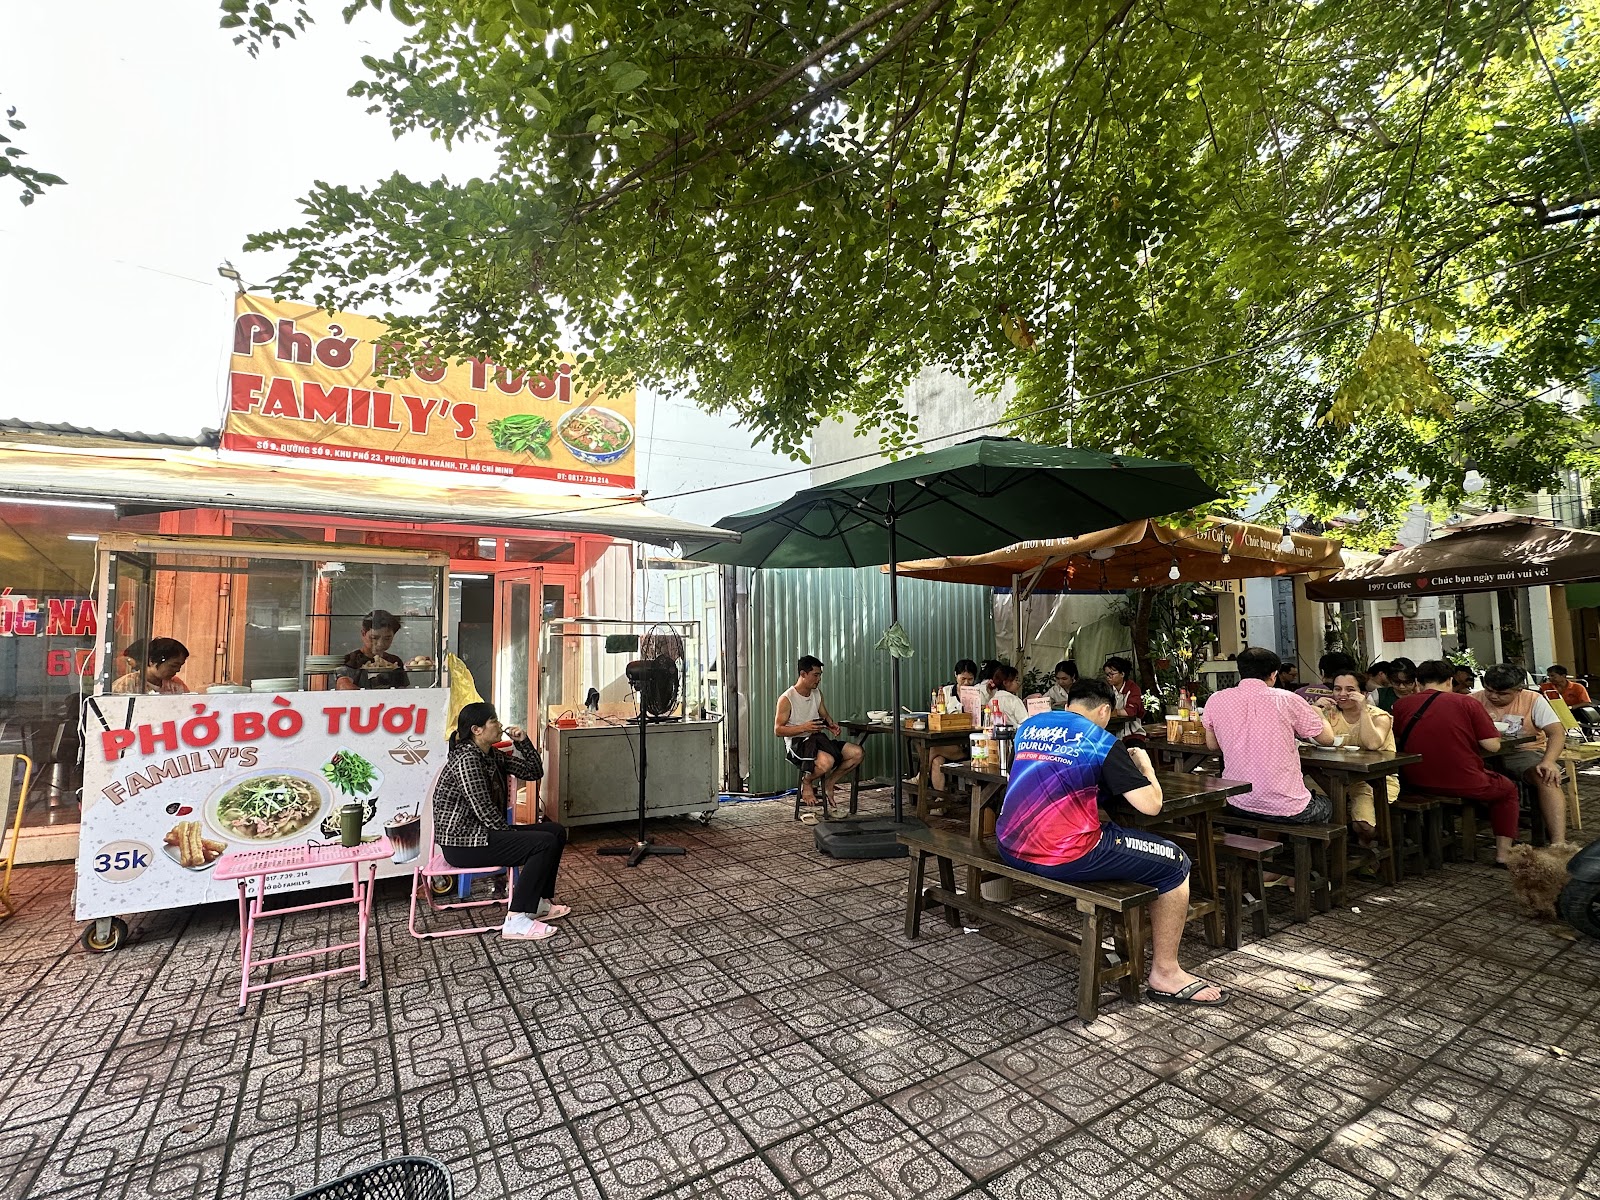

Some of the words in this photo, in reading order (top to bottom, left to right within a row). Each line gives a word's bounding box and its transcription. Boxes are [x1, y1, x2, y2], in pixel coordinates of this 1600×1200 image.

[233, 312, 359, 369] Phở
[230, 371, 478, 440] FAMILY'S
[312, 446, 324, 456] SỐ
[334, 449, 351, 459] KHU
[352, 451, 370, 461] PHỐ
[370, 453, 383, 463] 23,
[384, 454, 417, 465] PHƯỜNG
[418, 458, 429, 467] AN
[458, 462, 469, 471] TP.
[481, 464, 494, 473] CHÍ
[495, 466, 514, 475] MINH
[1368, 582, 1385, 591] 1997
[1386, 581, 1412, 590] Coffee
[1431, 576, 1453, 586] Chúc
[1455, 575, 1472, 585] bạn
[1473, 573, 1495, 584] ngày
[1496, 570, 1515, 580] mới
[1517, 568, 1532, 578] vui
[1534, 567, 1549, 577] vẻ!
[101, 703, 220, 762] PHỞ
[233, 695, 303, 742] BÒ
[322, 703, 428, 735] TƯƠI
[1018, 741, 1053, 751] EDURUN
[1054, 744, 1080, 758] 2025
[1038, 754, 1073, 765] EDUCATION
[101, 746, 259, 806] FAMILY'S
[94, 849, 148, 873] 35k
[1124, 836, 1176, 860] VINSCHOOL
